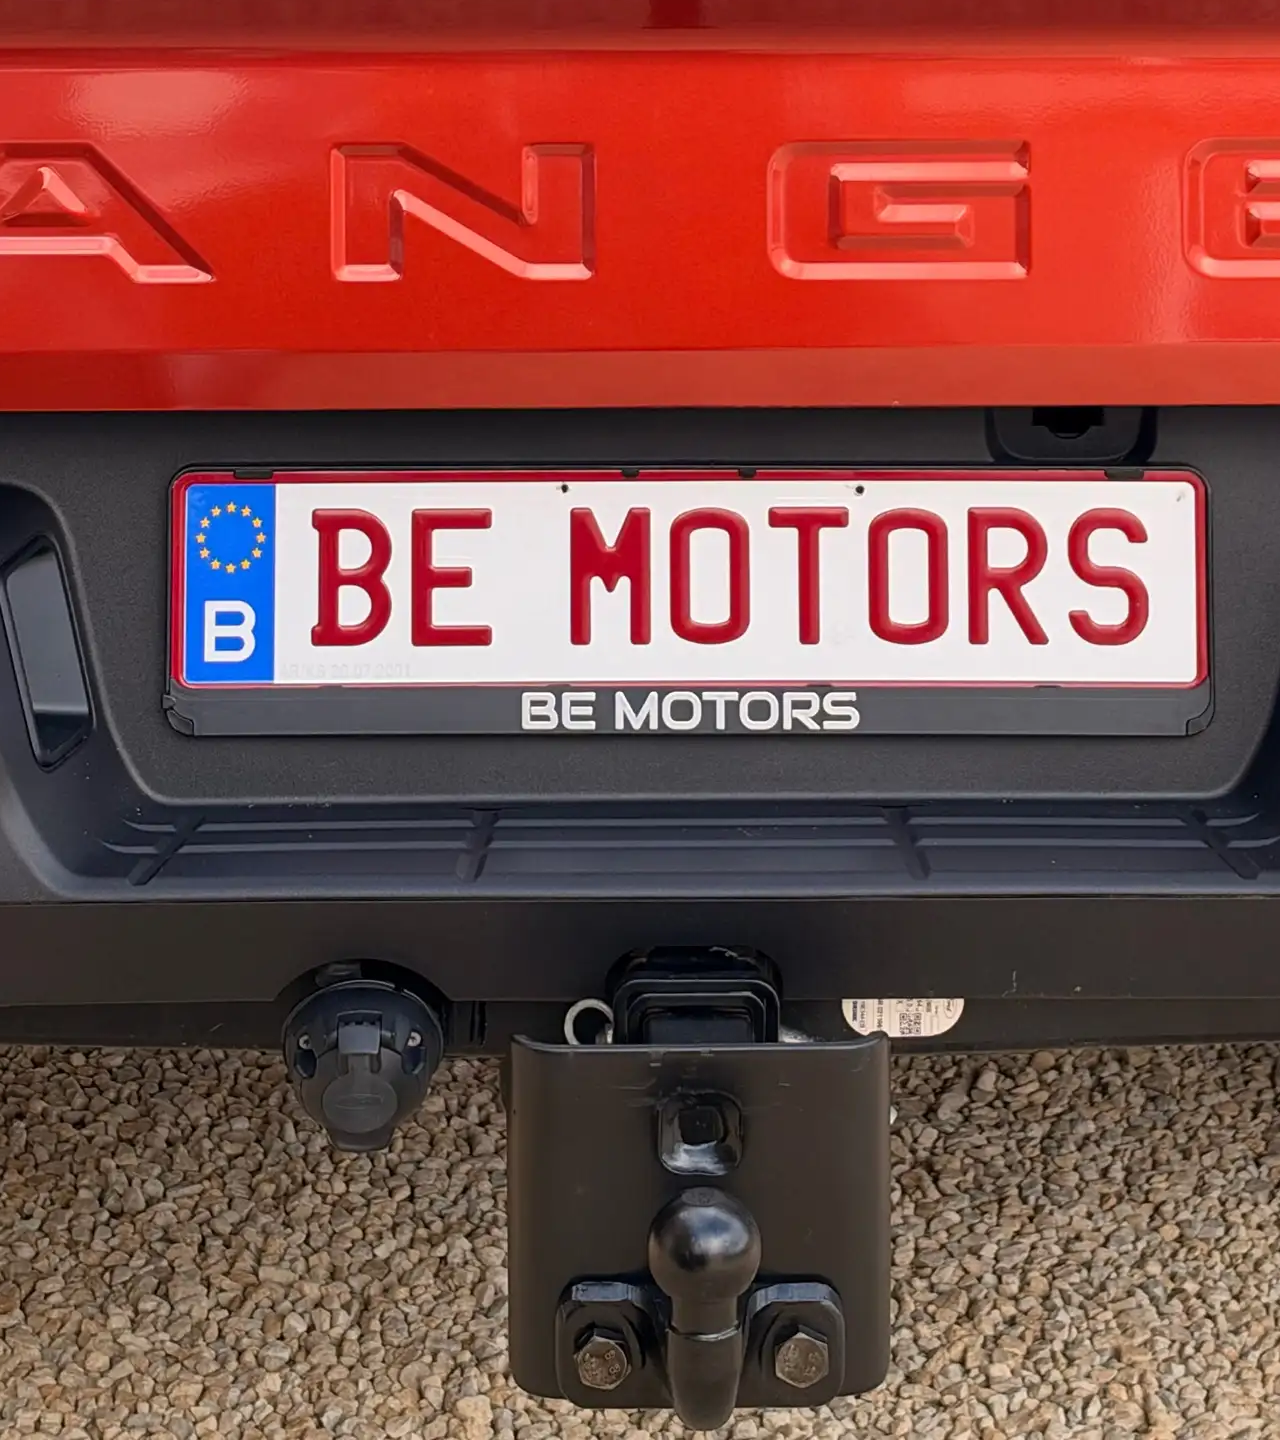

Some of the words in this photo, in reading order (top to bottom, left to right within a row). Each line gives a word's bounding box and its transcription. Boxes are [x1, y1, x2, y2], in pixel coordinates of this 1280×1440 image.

[311, 507, 493, 647] BE
[570, 506, 1149, 647] MOTORS
[202, 600, 256, 663] B
[521, 691, 596, 730] BE
[615, 691, 860, 730] MOTORS
